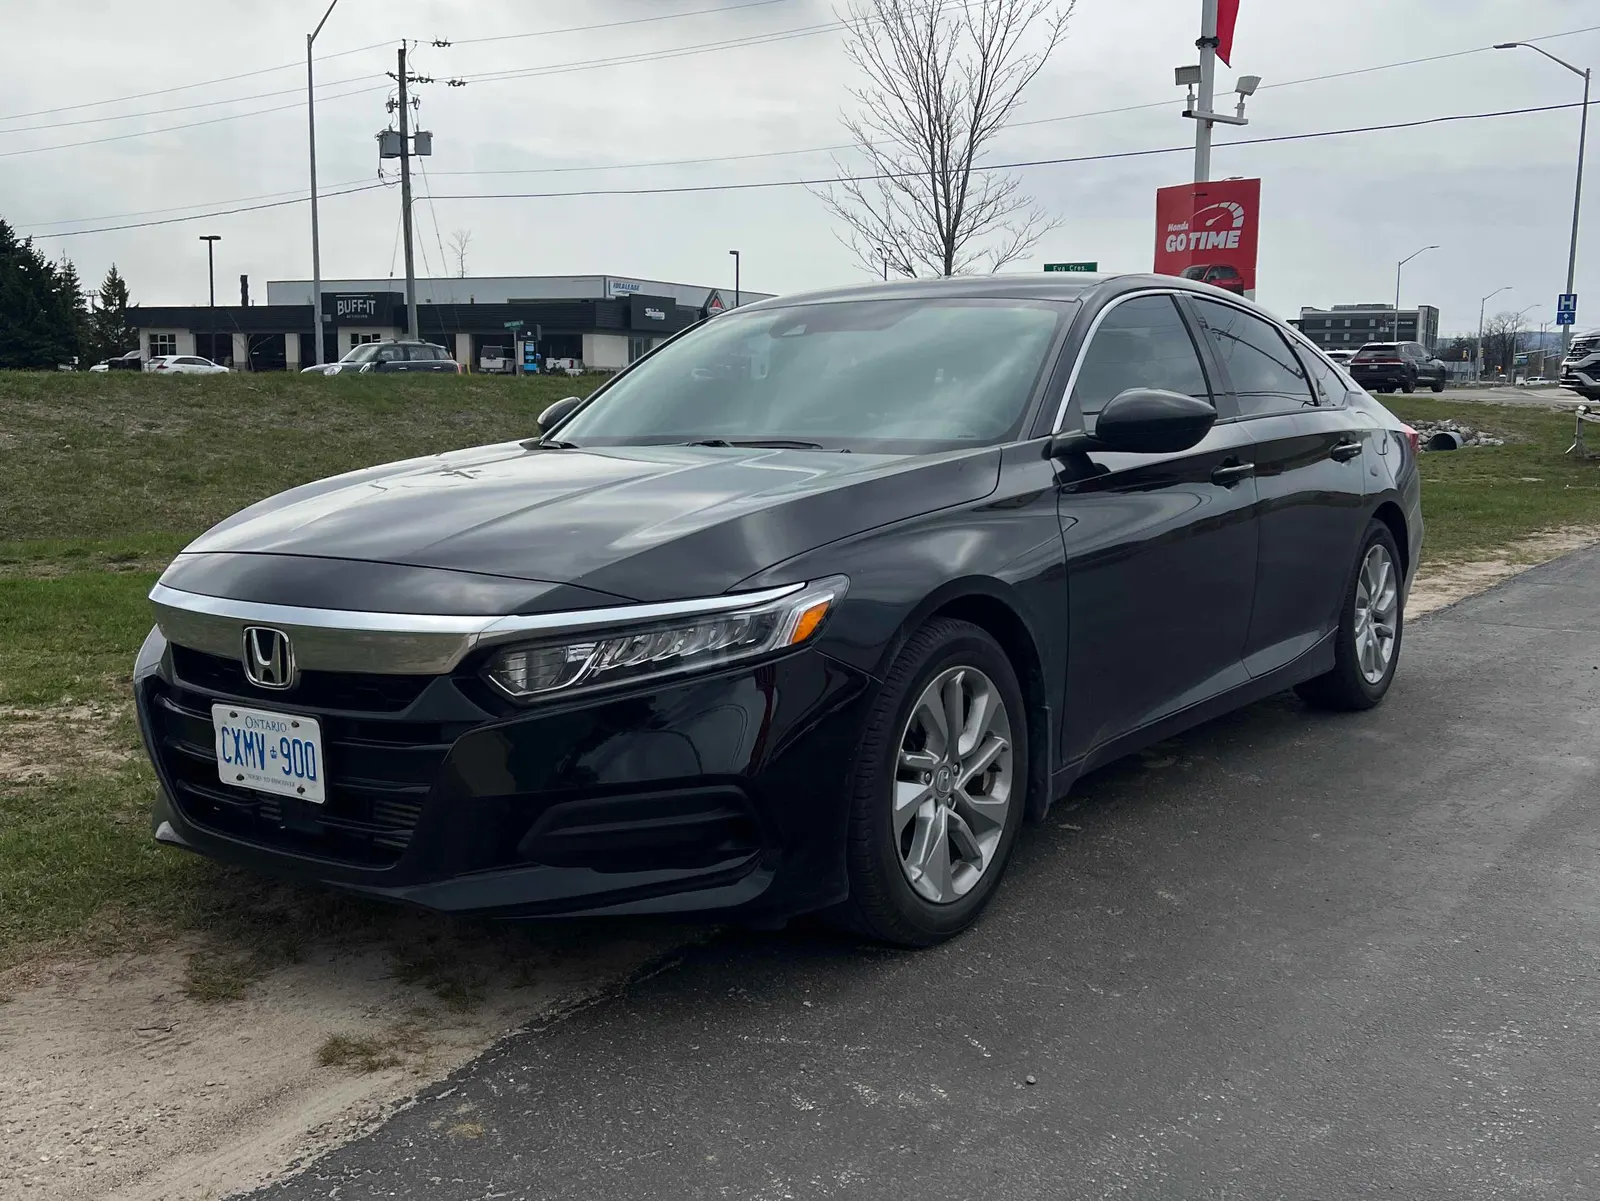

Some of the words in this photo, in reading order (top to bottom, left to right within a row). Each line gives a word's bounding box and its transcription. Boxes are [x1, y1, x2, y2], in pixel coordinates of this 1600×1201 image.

[1168, 221, 1188, 232] Honda
[1560, 295, 1574, 310] H
[245, 716, 287, 732] ONTARIO
[221, 726, 265, 771] CXMV
[280, 737, 317, 781] 900
